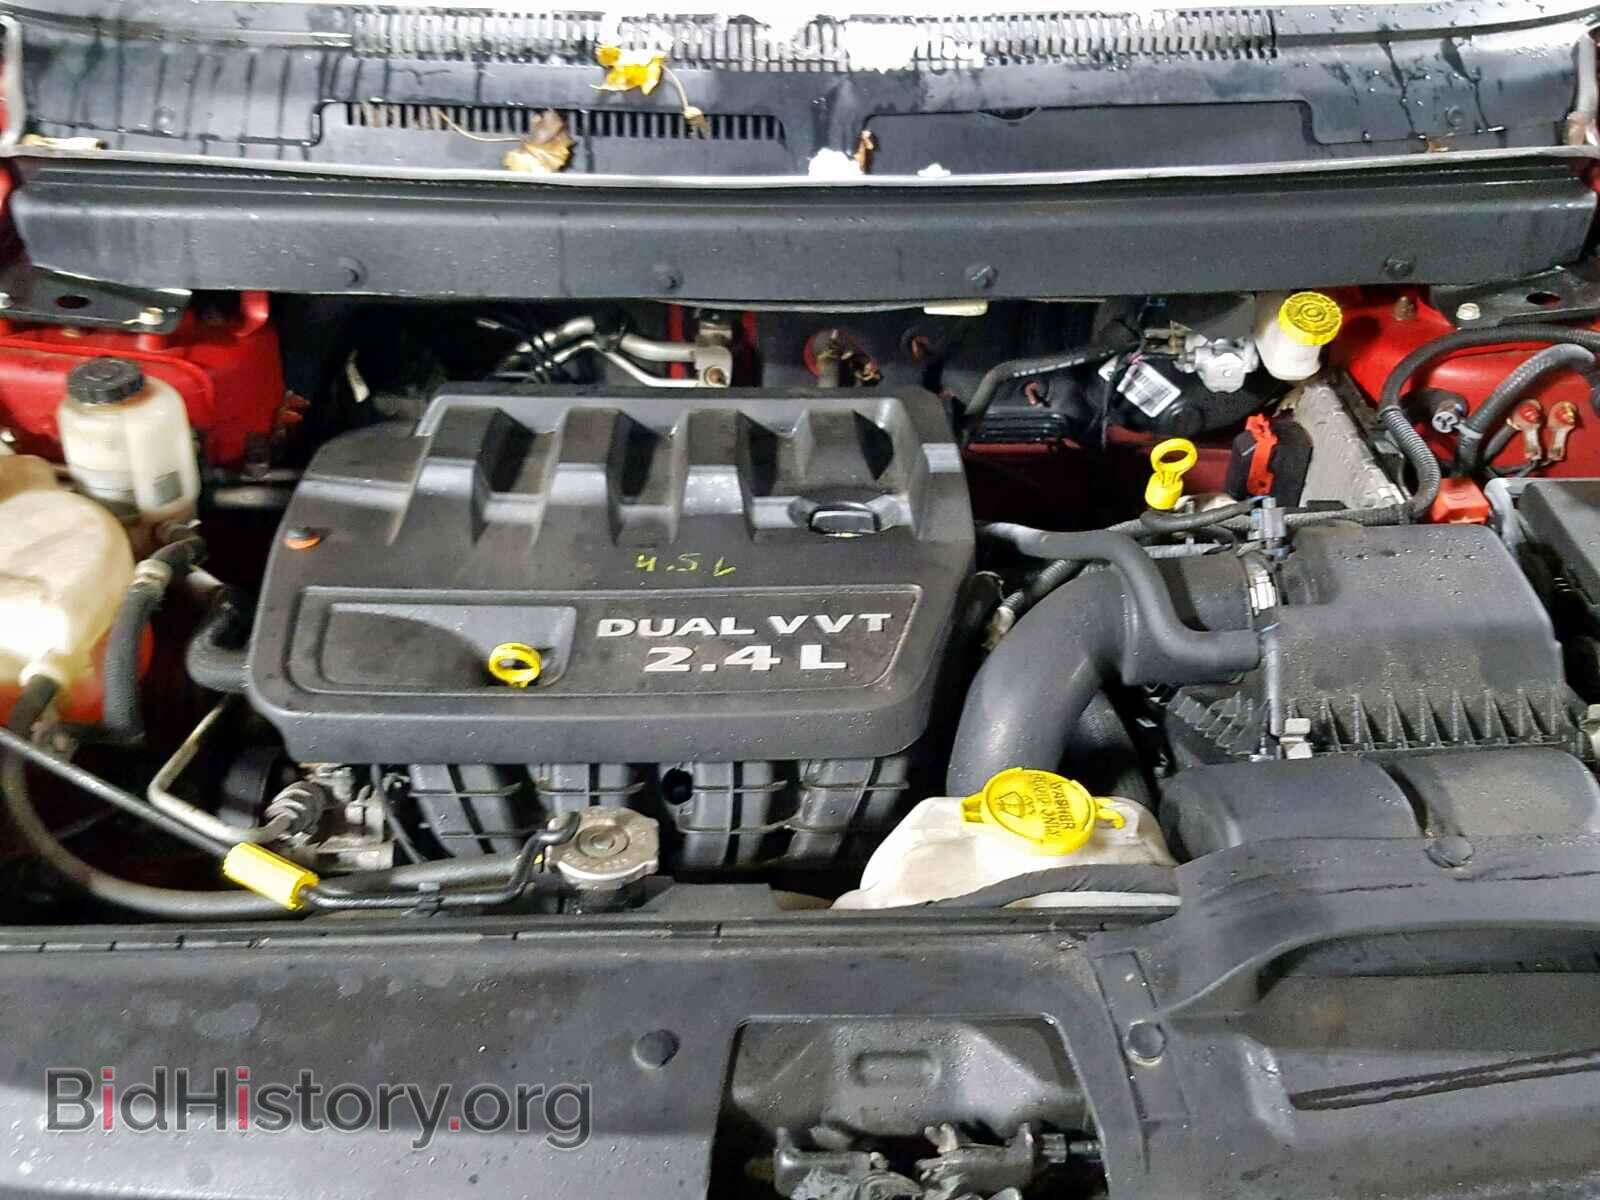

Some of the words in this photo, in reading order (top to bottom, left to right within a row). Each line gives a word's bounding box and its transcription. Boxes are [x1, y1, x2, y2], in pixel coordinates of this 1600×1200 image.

[596, 616, 756, 637] DUAL
[767, 613, 892, 635] VVT
[644, 644, 782, 672] 2.4
[800, 643, 847, 670] L
